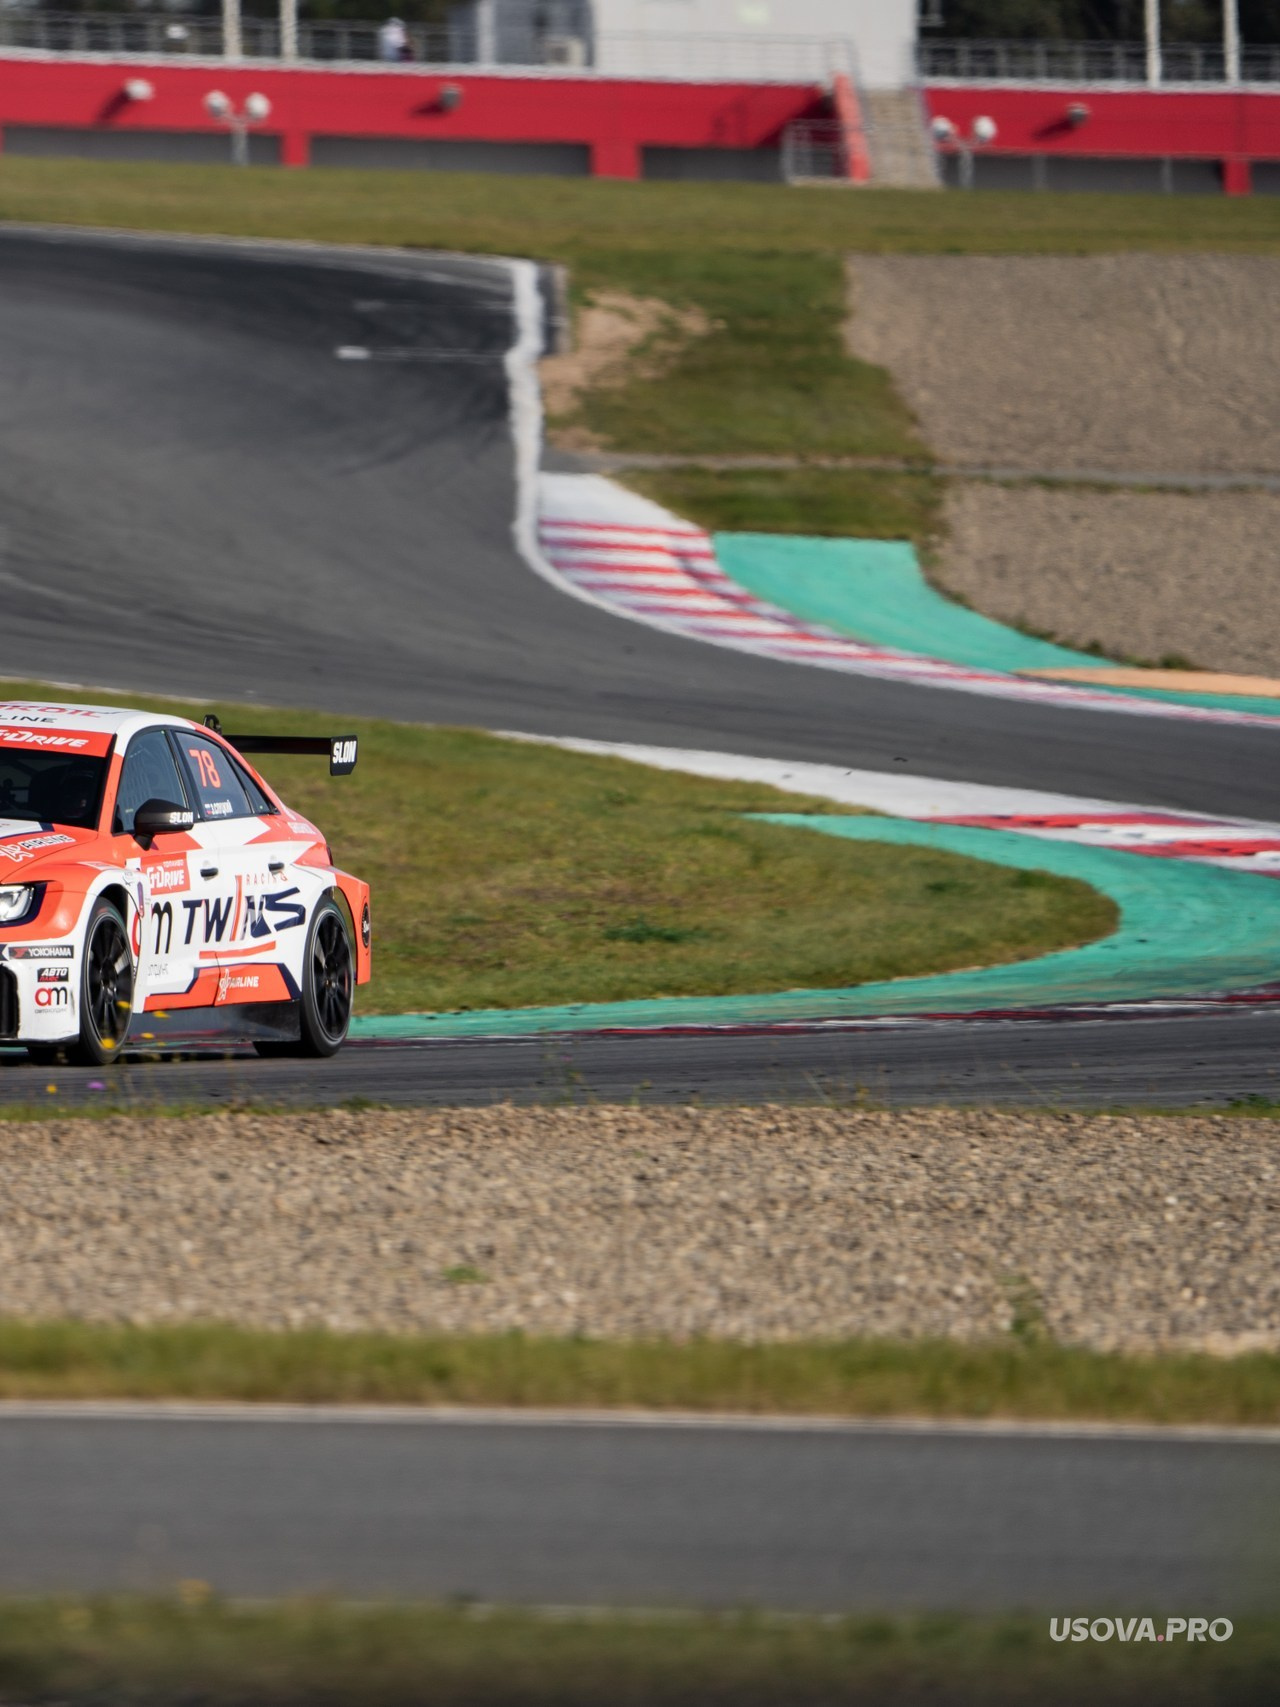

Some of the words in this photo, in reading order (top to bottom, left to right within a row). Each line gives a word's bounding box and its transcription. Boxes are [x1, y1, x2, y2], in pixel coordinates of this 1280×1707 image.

[333, 740, 358, 764] SLON
[189, 749, 221, 788] 78
[169, 811, 194, 824] SLON
[20, 834, 77, 850] AIRLINE
[182, 887, 306, 945] TWINS
[28, 948, 72, 957] YOKOHAMA
[41, 968, 68, 977] АВТО
